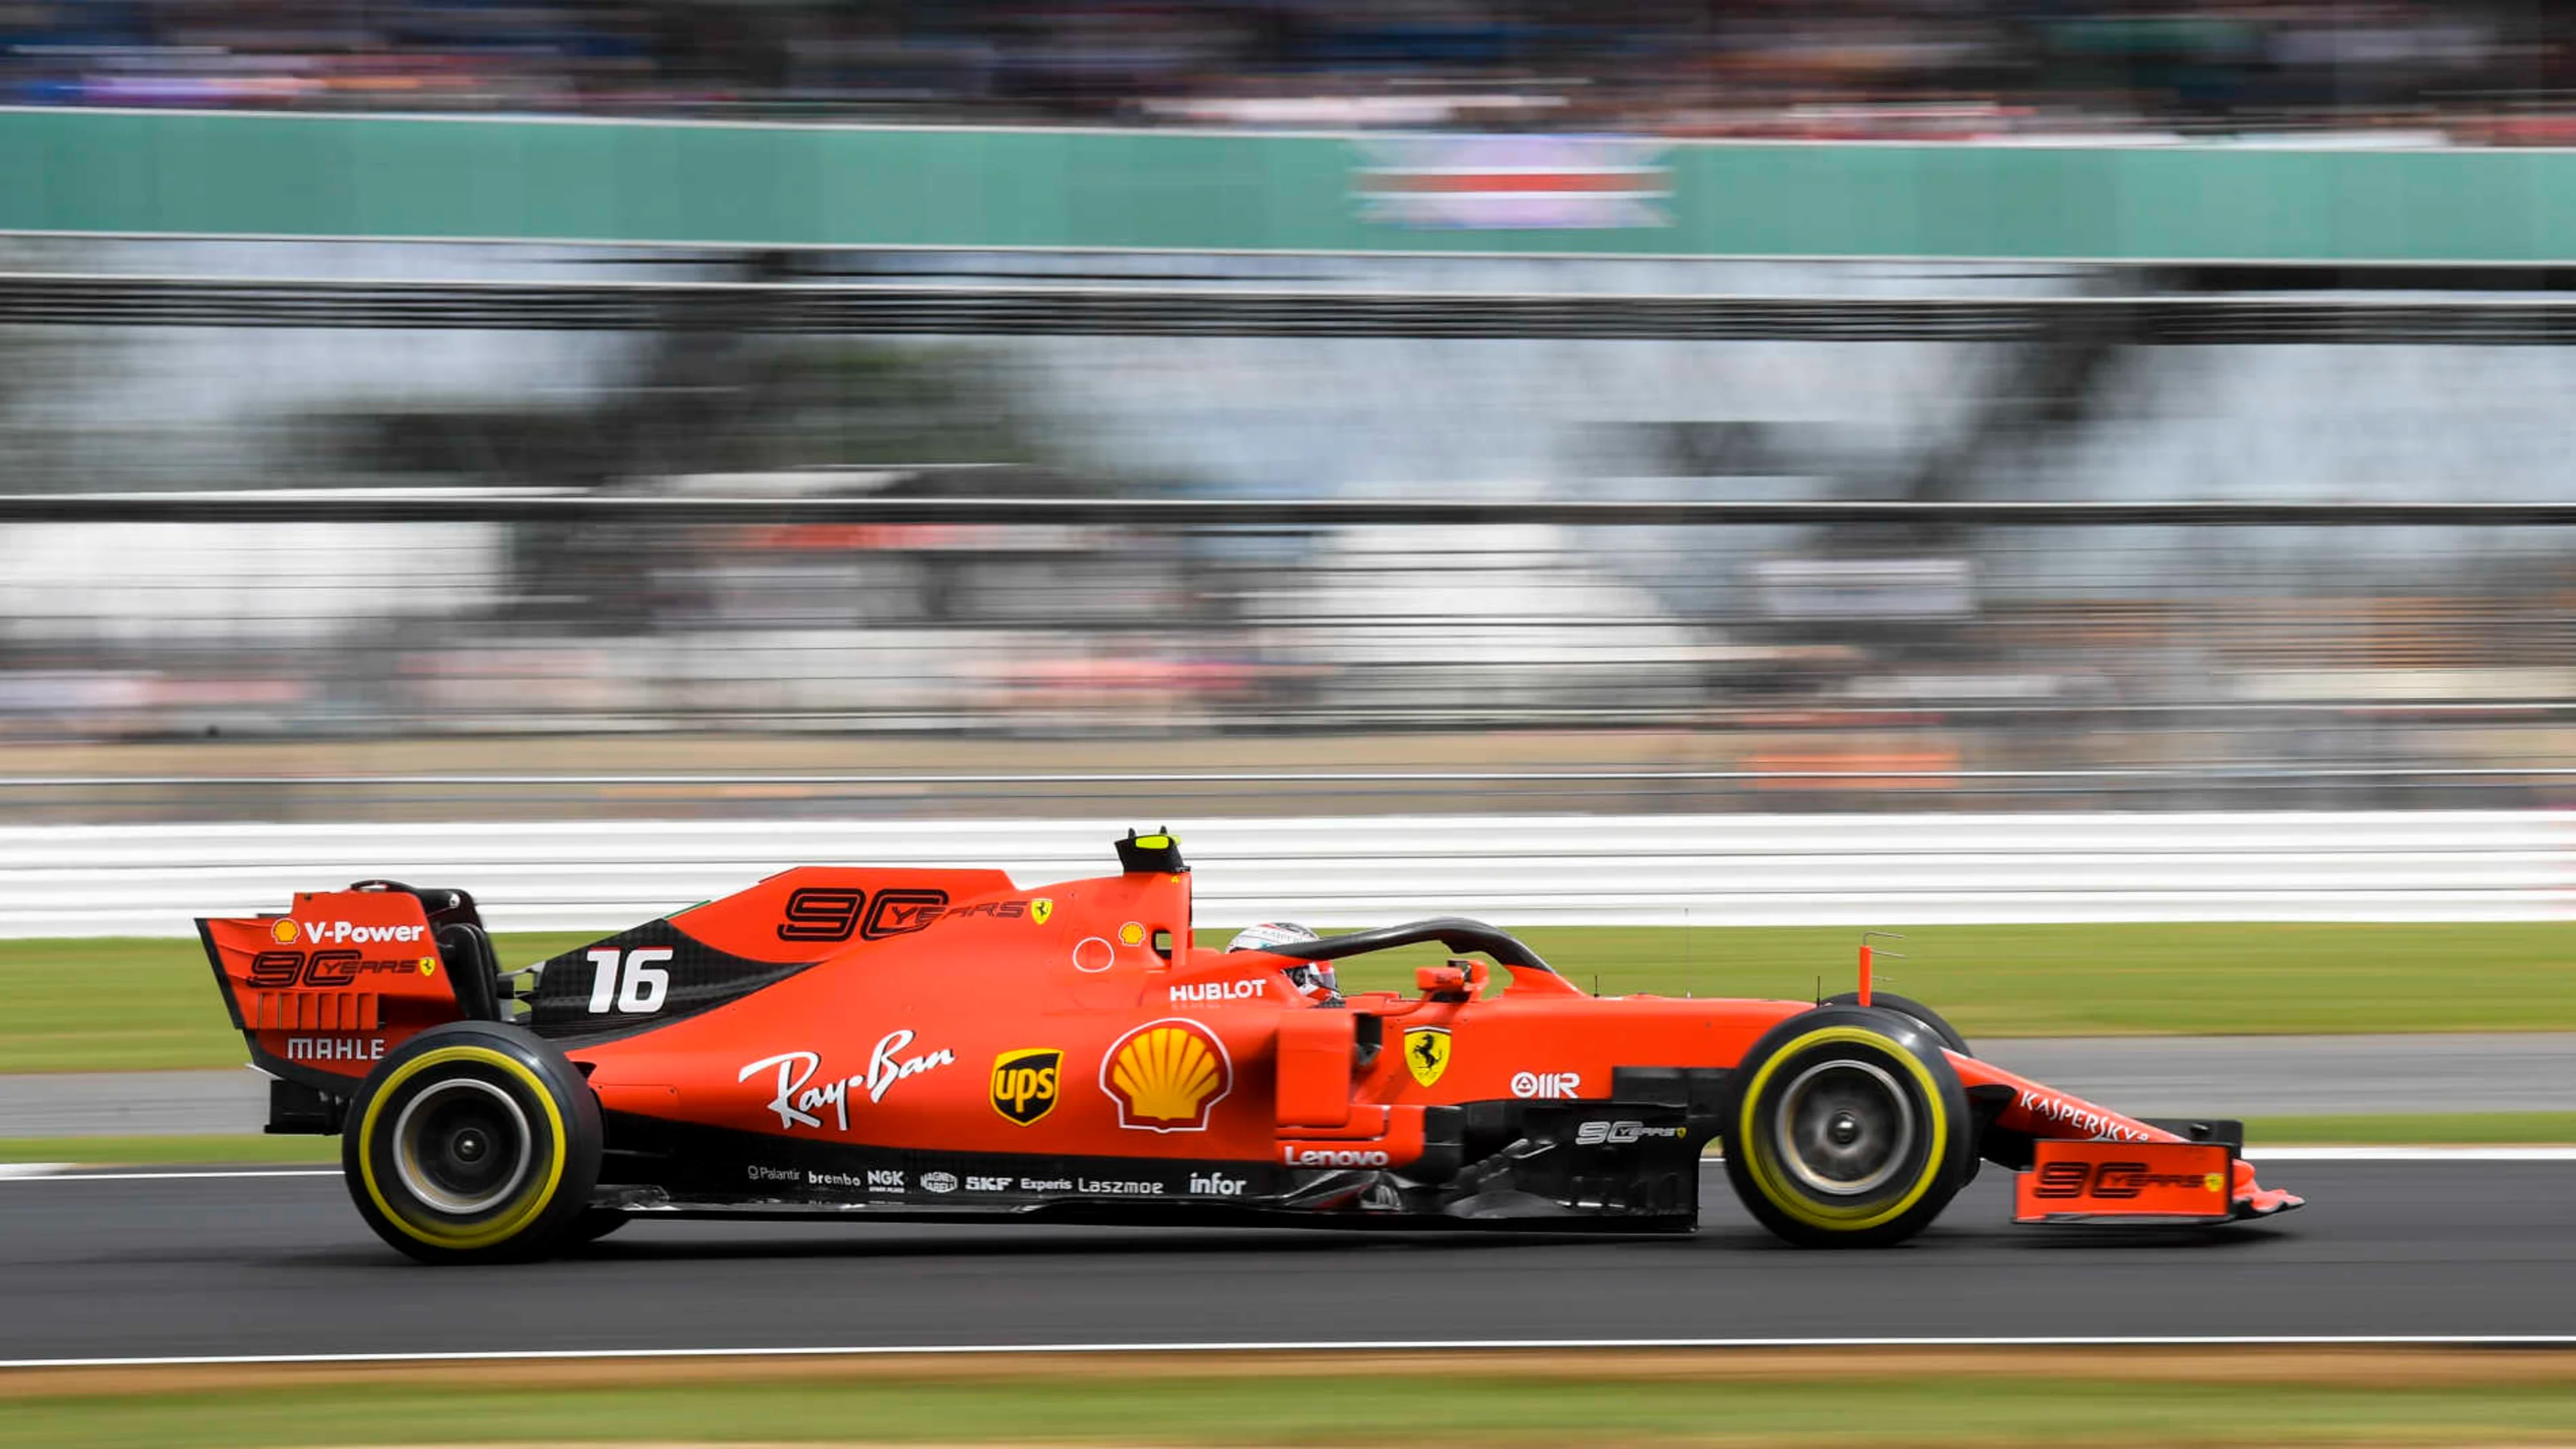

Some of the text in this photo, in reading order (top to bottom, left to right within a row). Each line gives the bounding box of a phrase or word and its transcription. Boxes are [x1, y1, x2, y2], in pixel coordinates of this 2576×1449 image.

[777, 887, 1029, 942] 90 YEARS
[304, 921, 424, 944] V-Power
[246, 950, 420, 989] 90 YEARS
[586, 947, 673, 1013] 16
[1170, 979, 1267, 1001] HUBLOT
[287, 1038, 386, 1060] MAHLE
[995, 1067, 1056, 1113] ups
[1284, 1146, 1389, 1166] Lenovo
[760, 1166, 800, 1181] Palantir
[808, 1170, 862, 1187] brembo
[867, 1170, 904, 1186] NGK
[965, 1176, 1014, 1191] SKF
[1020, 1178, 1073, 1191] Experis
[1189, 1172, 1247, 1195] infor
[1077, 1178, 1164, 1194] Laszmoe
